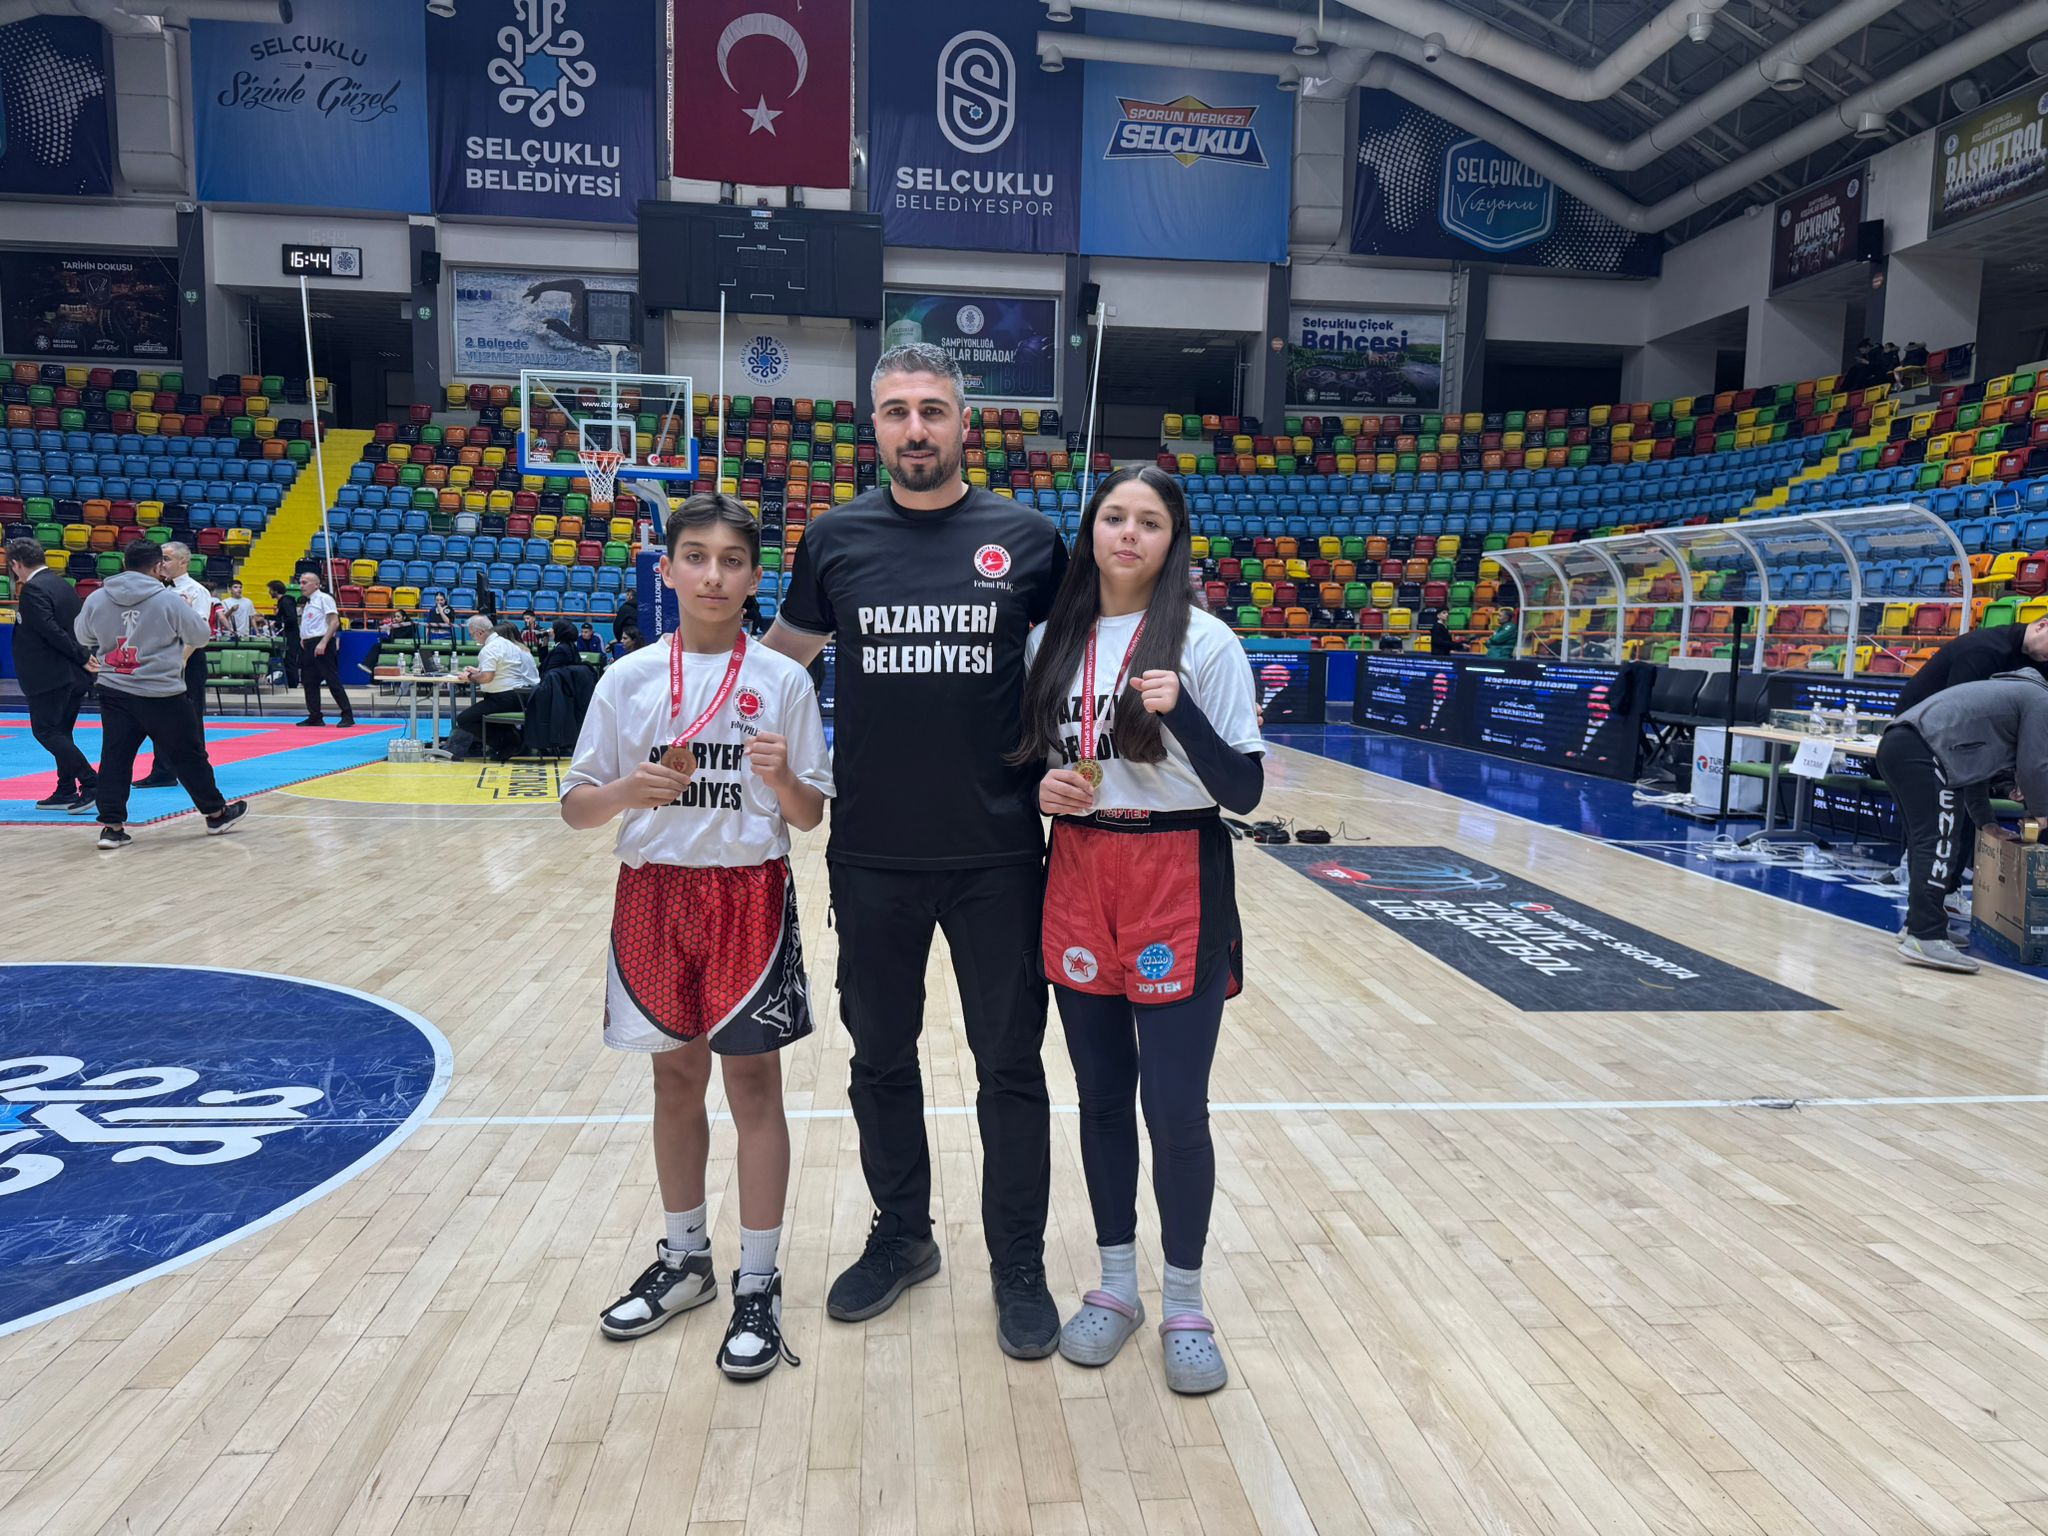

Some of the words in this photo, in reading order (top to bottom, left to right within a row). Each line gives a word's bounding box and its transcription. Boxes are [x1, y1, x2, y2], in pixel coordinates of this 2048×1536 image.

[250, 35, 367, 67] SELÇUKLU
[217, 71, 306, 112] Sizinle
[317, 76, 401, 123] Güzel
[1129, 108, 1184, 122] SPORUN
[466, 136, 620, 168] SELÇUKLU
[1120, 125, 1250, 155] SELÇUKLU
[466, 168, 621, 197] BELEDİYESİ
[896, 167, 1054, 197] SELÇUKLU
[1456, 157, 1544, 188] SELÇUKLU
[896, 194, 1053, 216] BELEDİYESPOR
[1457, 186, 1538, 224] Vizyonu
[753, 221, 769, 230] SCORE
[62, 261, 95, 270] TARİHİN
[97, 262, 133, 271] DOKUSU
[291, 252, 330, 268] 16:44
[1302, 317, 1356, 330] Selçuklu
[1359, 319, 1394, 332] Çiçek
[478, 337, 529, 350] Bölgede
[973, 349, 1015, 363] BURADA!
[858, 601, 997, 635] PAZARYERİ
[862, 641, 993, 674] BELEDİYESİ
[1367, 900, 1441, 921] LİGİ
[1410, 900, 1583, 976] BASKETBOL
[1461, 901, 1595, 952] TÜRKİYE
[1155, 981, 1182, 994] TEN
